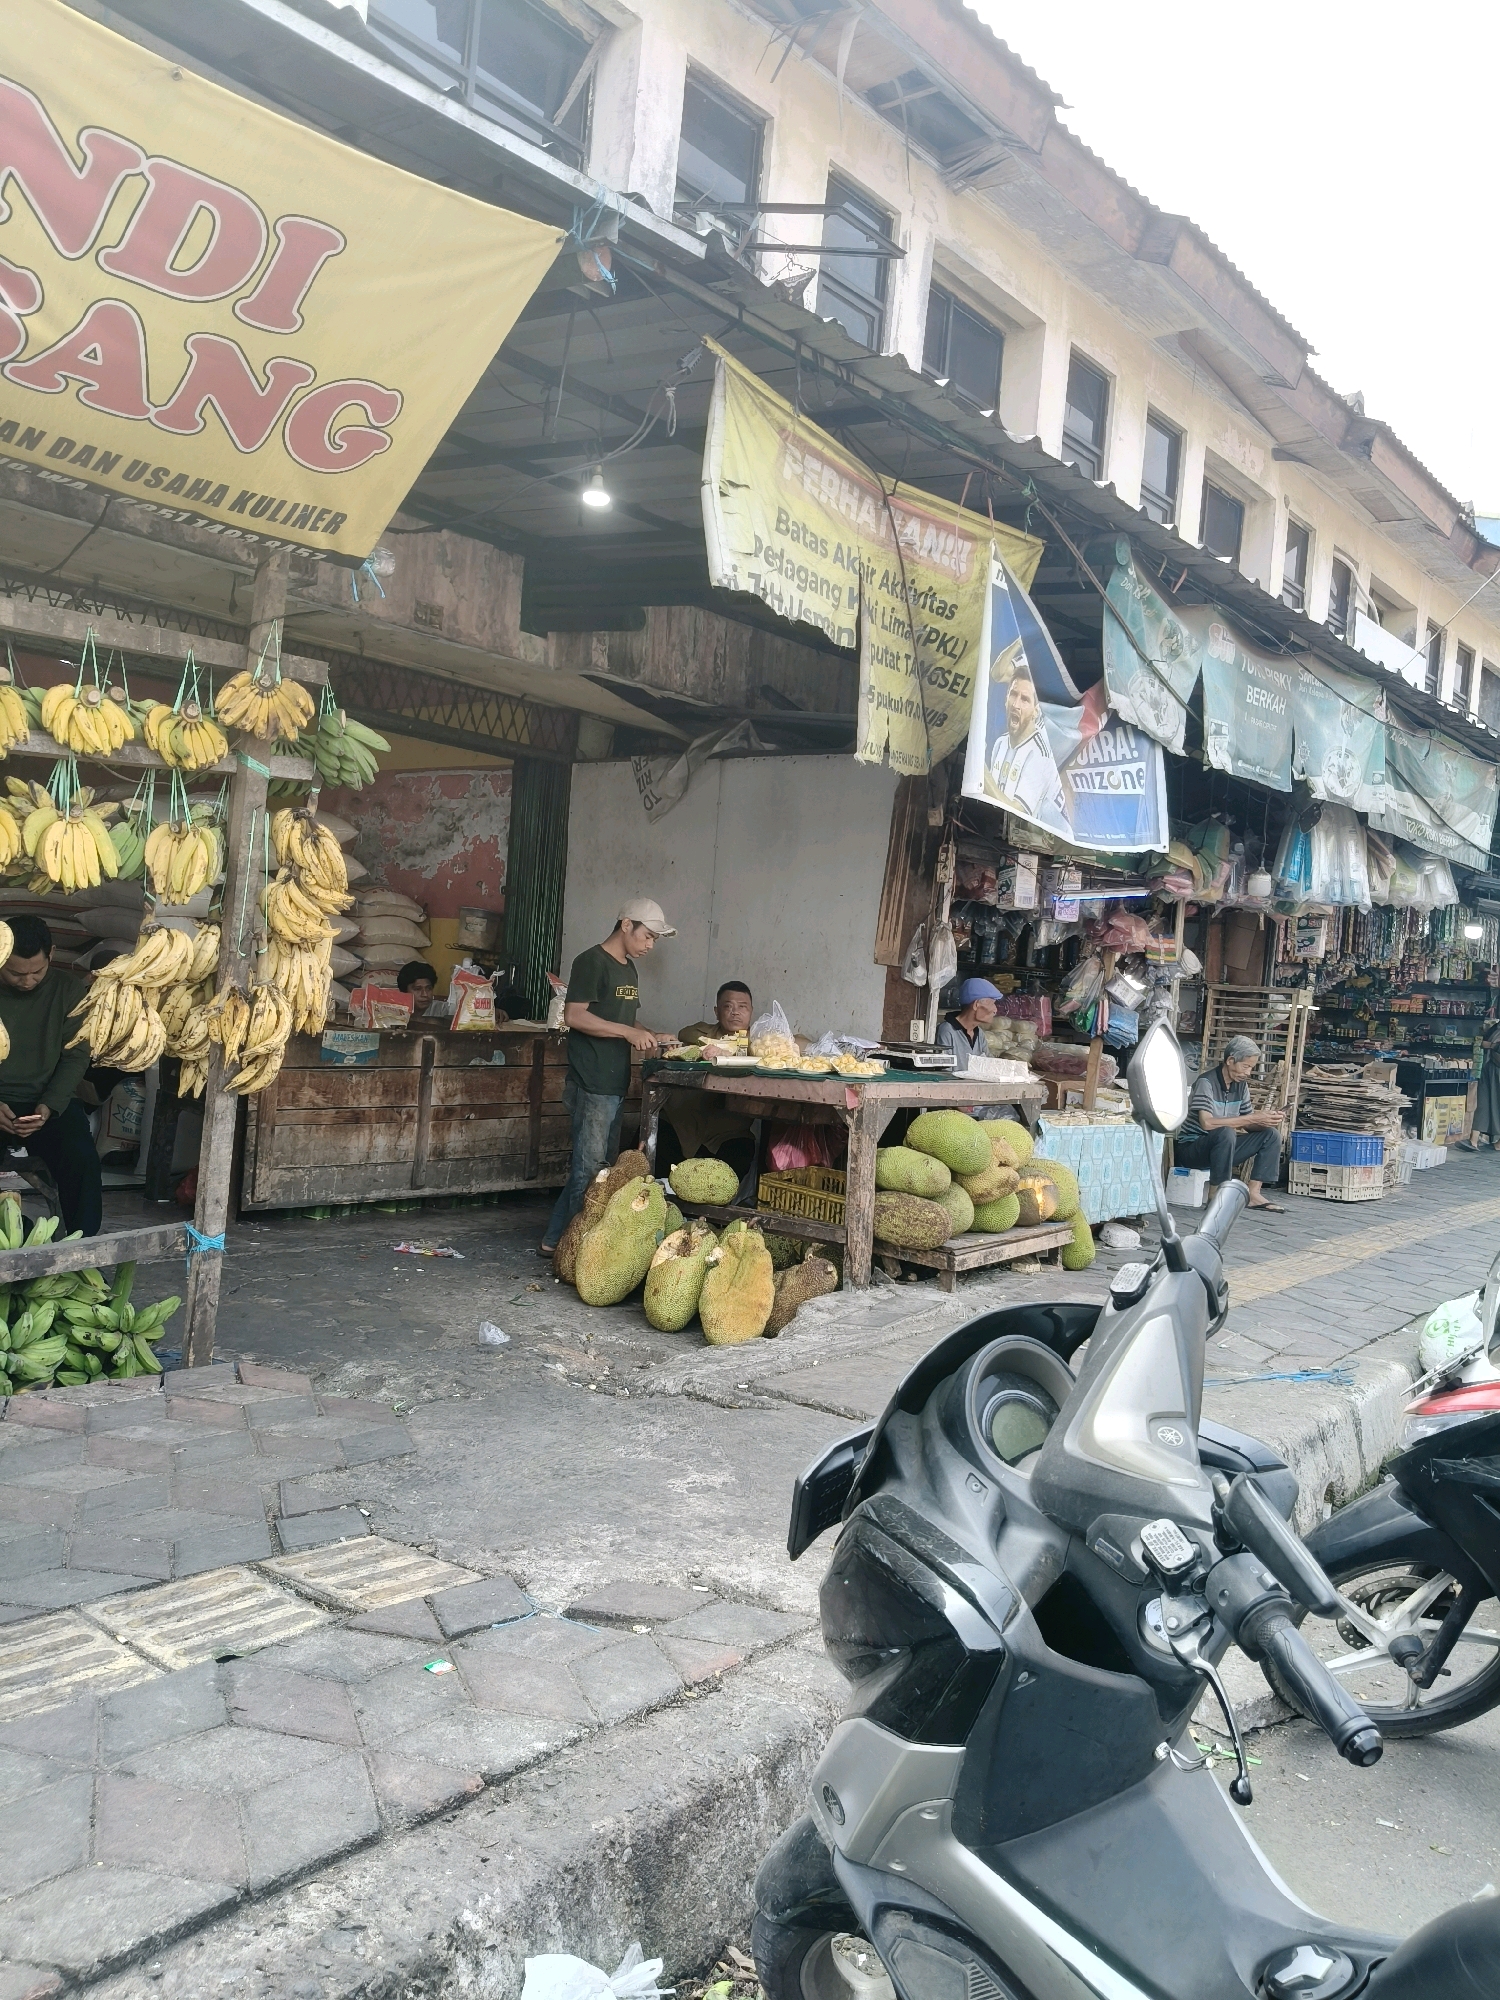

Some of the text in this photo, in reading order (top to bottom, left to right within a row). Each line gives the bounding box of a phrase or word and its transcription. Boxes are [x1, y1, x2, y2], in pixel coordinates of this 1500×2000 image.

[45, 436, 123, 475] DAN
[121, 458, 230, 508] USAHA
[227, 490, 348, 535] KULINER
[775, 506, 828, 558] Batas
[1246, 684, 1287, 716] BERKAH
[1069, 724, 1139, 767] UARA!
[1071, 767, 1145, 790] mizone
